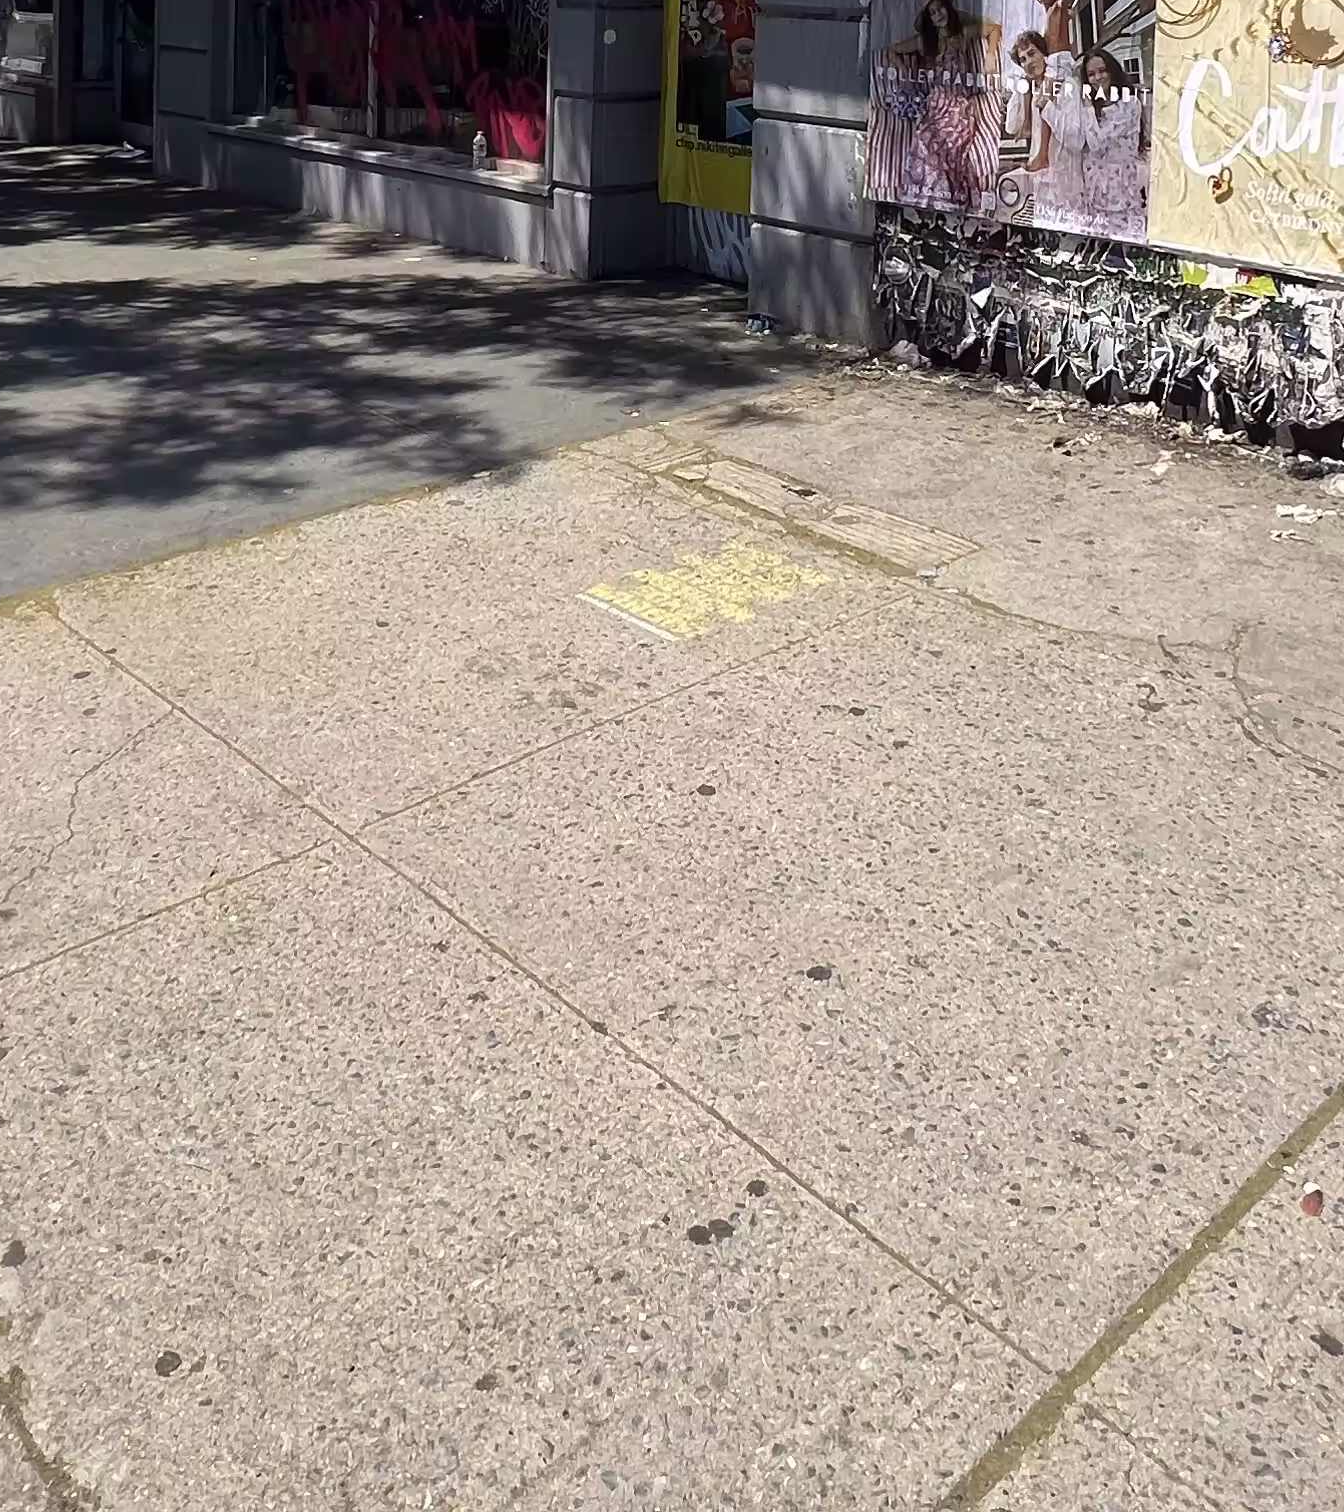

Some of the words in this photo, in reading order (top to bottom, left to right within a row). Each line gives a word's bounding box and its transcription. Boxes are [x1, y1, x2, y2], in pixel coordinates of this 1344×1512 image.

[877, 66, 935, 85] ROLLER
[943, 70, 1001, 88] RABBIT
[1005, 78, 1074, 99] ROLLER
[1082, 83, 1150, 105] RABBIT
[1246, 180, 1294, 204] Solid
